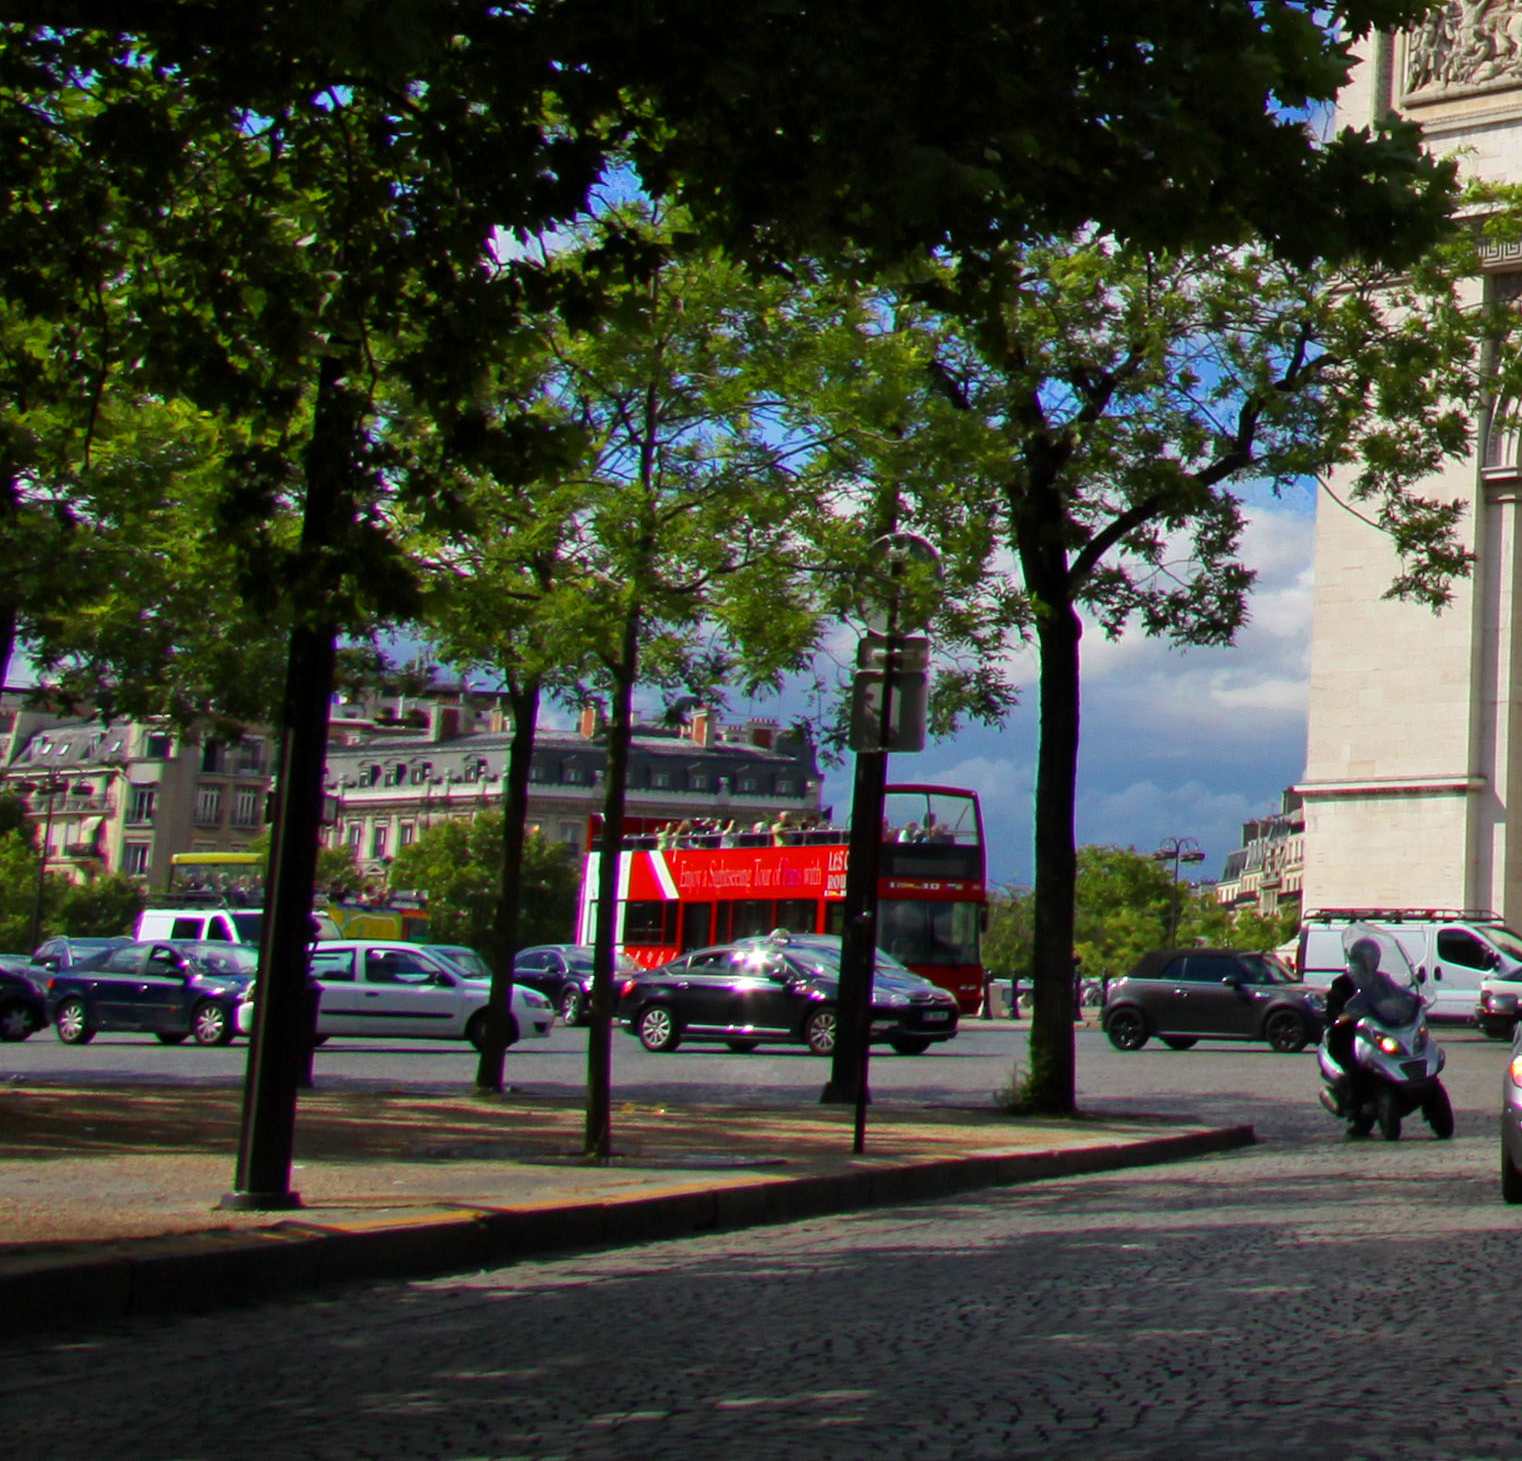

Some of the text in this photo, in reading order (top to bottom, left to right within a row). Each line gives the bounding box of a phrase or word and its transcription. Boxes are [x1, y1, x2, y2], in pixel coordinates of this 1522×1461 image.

[754, 858, 772, 887] Tour
[772, 857, 784, 886] of
[828, 851, 844, 871] LES
